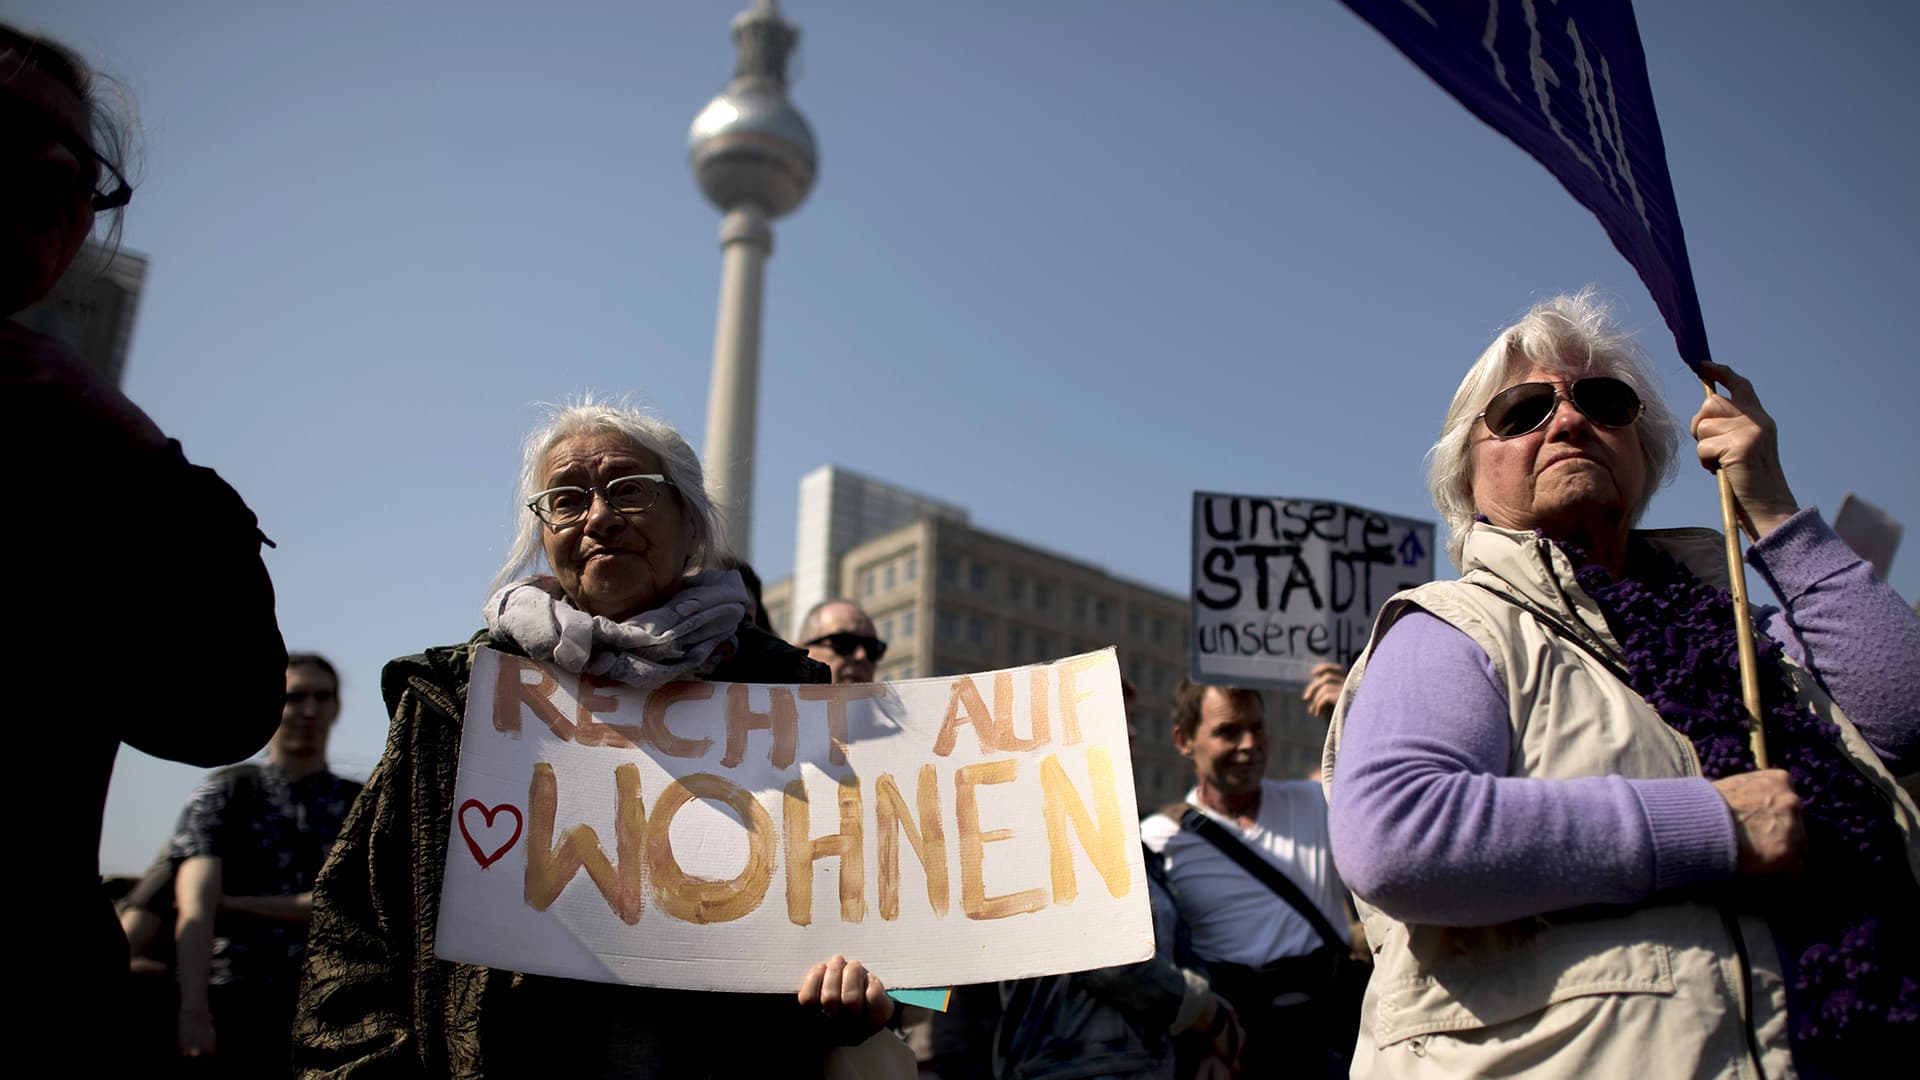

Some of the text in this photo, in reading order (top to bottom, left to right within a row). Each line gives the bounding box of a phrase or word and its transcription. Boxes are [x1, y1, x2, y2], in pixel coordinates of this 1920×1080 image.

[1197, 544, 1395, 616] STADT
[492, 653, 1110, 768] RECHT AUF
[523, 745, 1132, 926] WOHNEN
